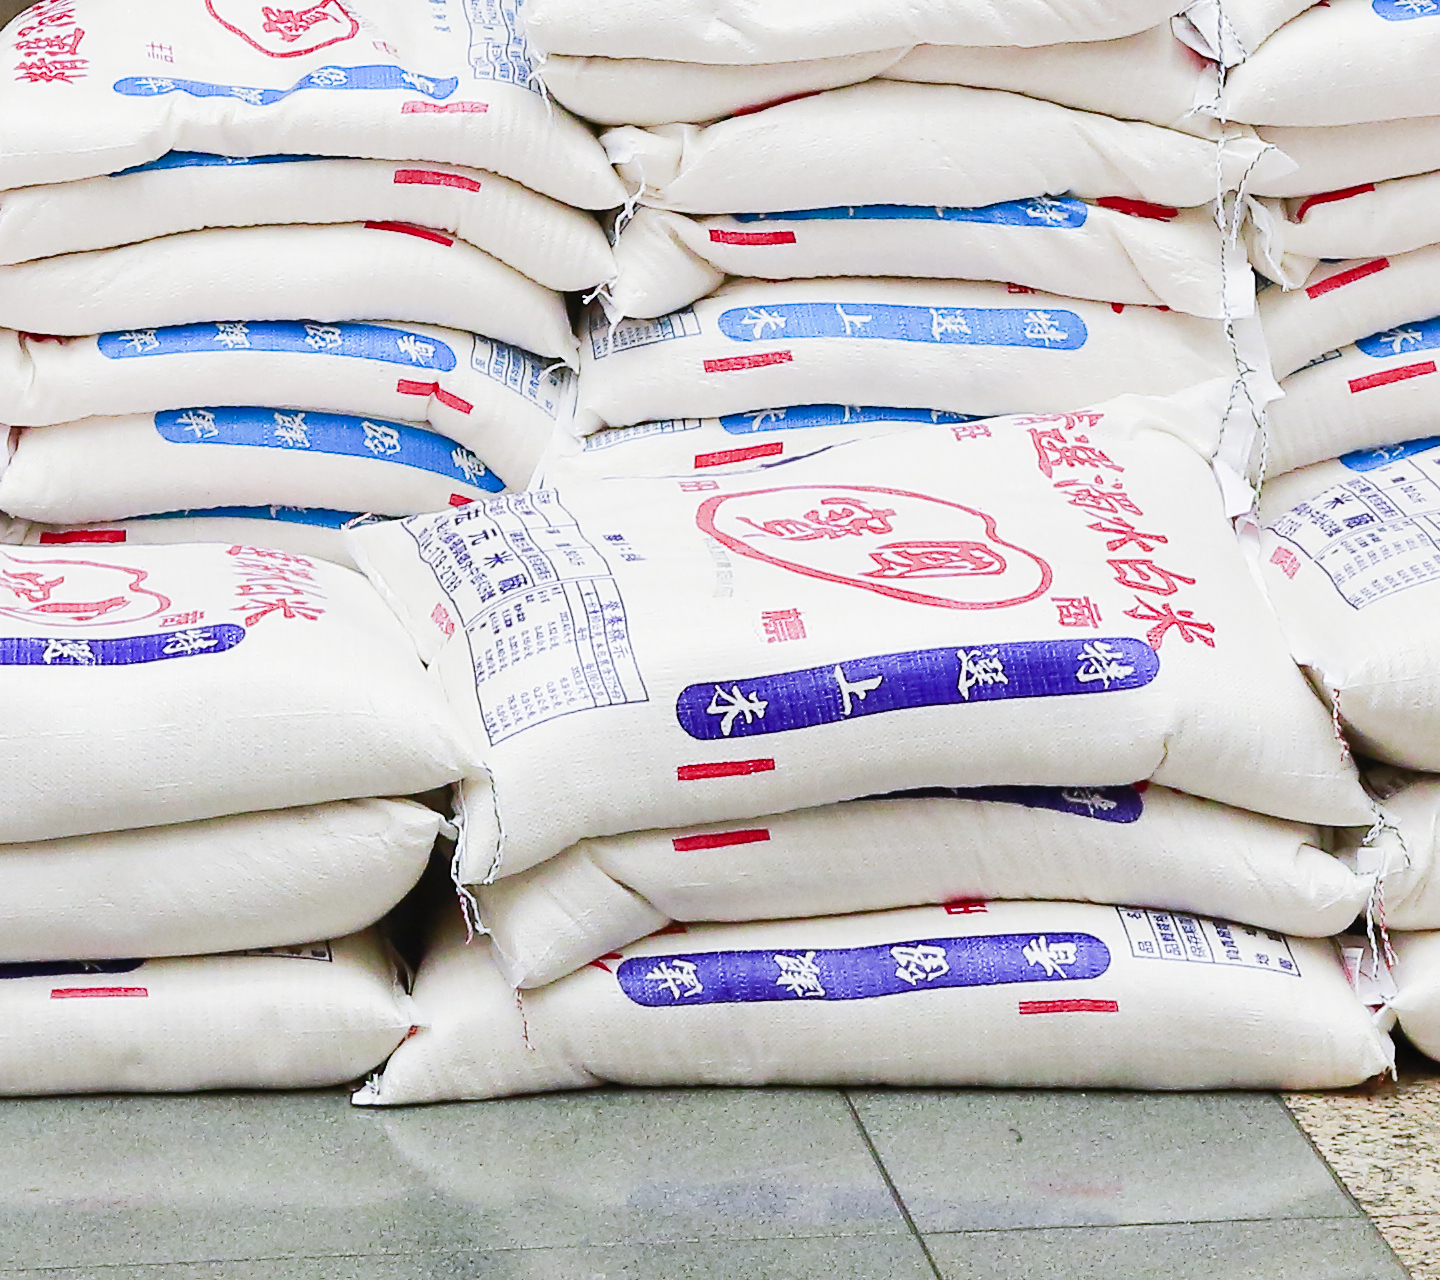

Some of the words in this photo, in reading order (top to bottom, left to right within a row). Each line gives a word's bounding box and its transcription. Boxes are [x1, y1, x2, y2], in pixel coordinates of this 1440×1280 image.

[1048, 597, 1101, 628] 商
[707, 640, 1130, 736] 特選上米
